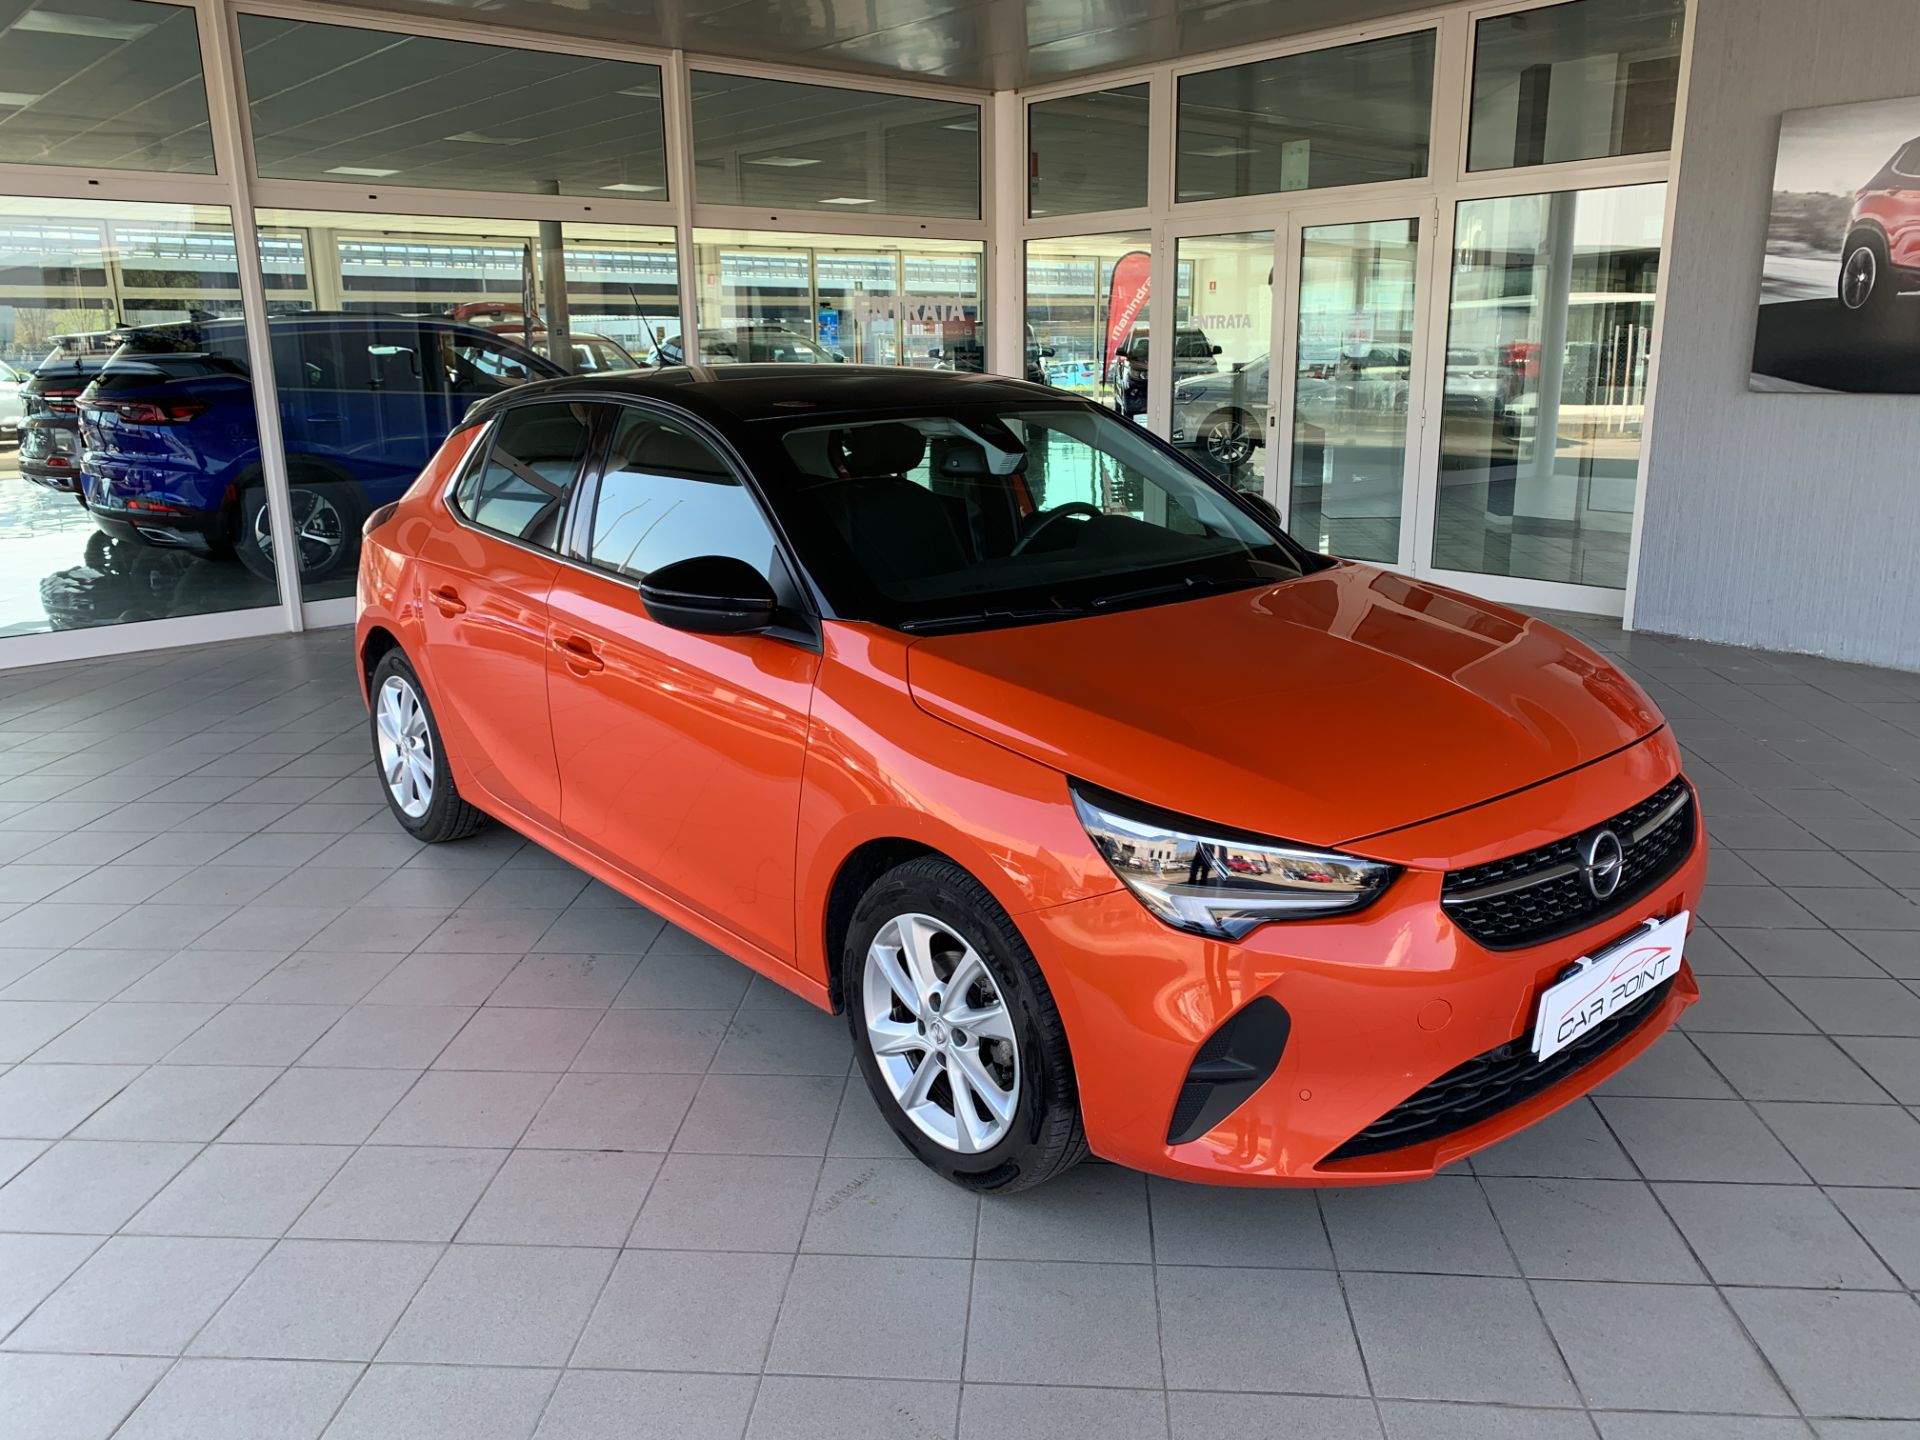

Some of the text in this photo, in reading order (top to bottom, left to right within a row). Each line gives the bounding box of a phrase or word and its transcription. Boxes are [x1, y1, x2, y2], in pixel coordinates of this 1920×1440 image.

[855, 296, 966, 322] ENTRATA
[1190, 314, 1252, 330] ENTRATA
[1557, 955, 1671, 1043] CAR POINT
